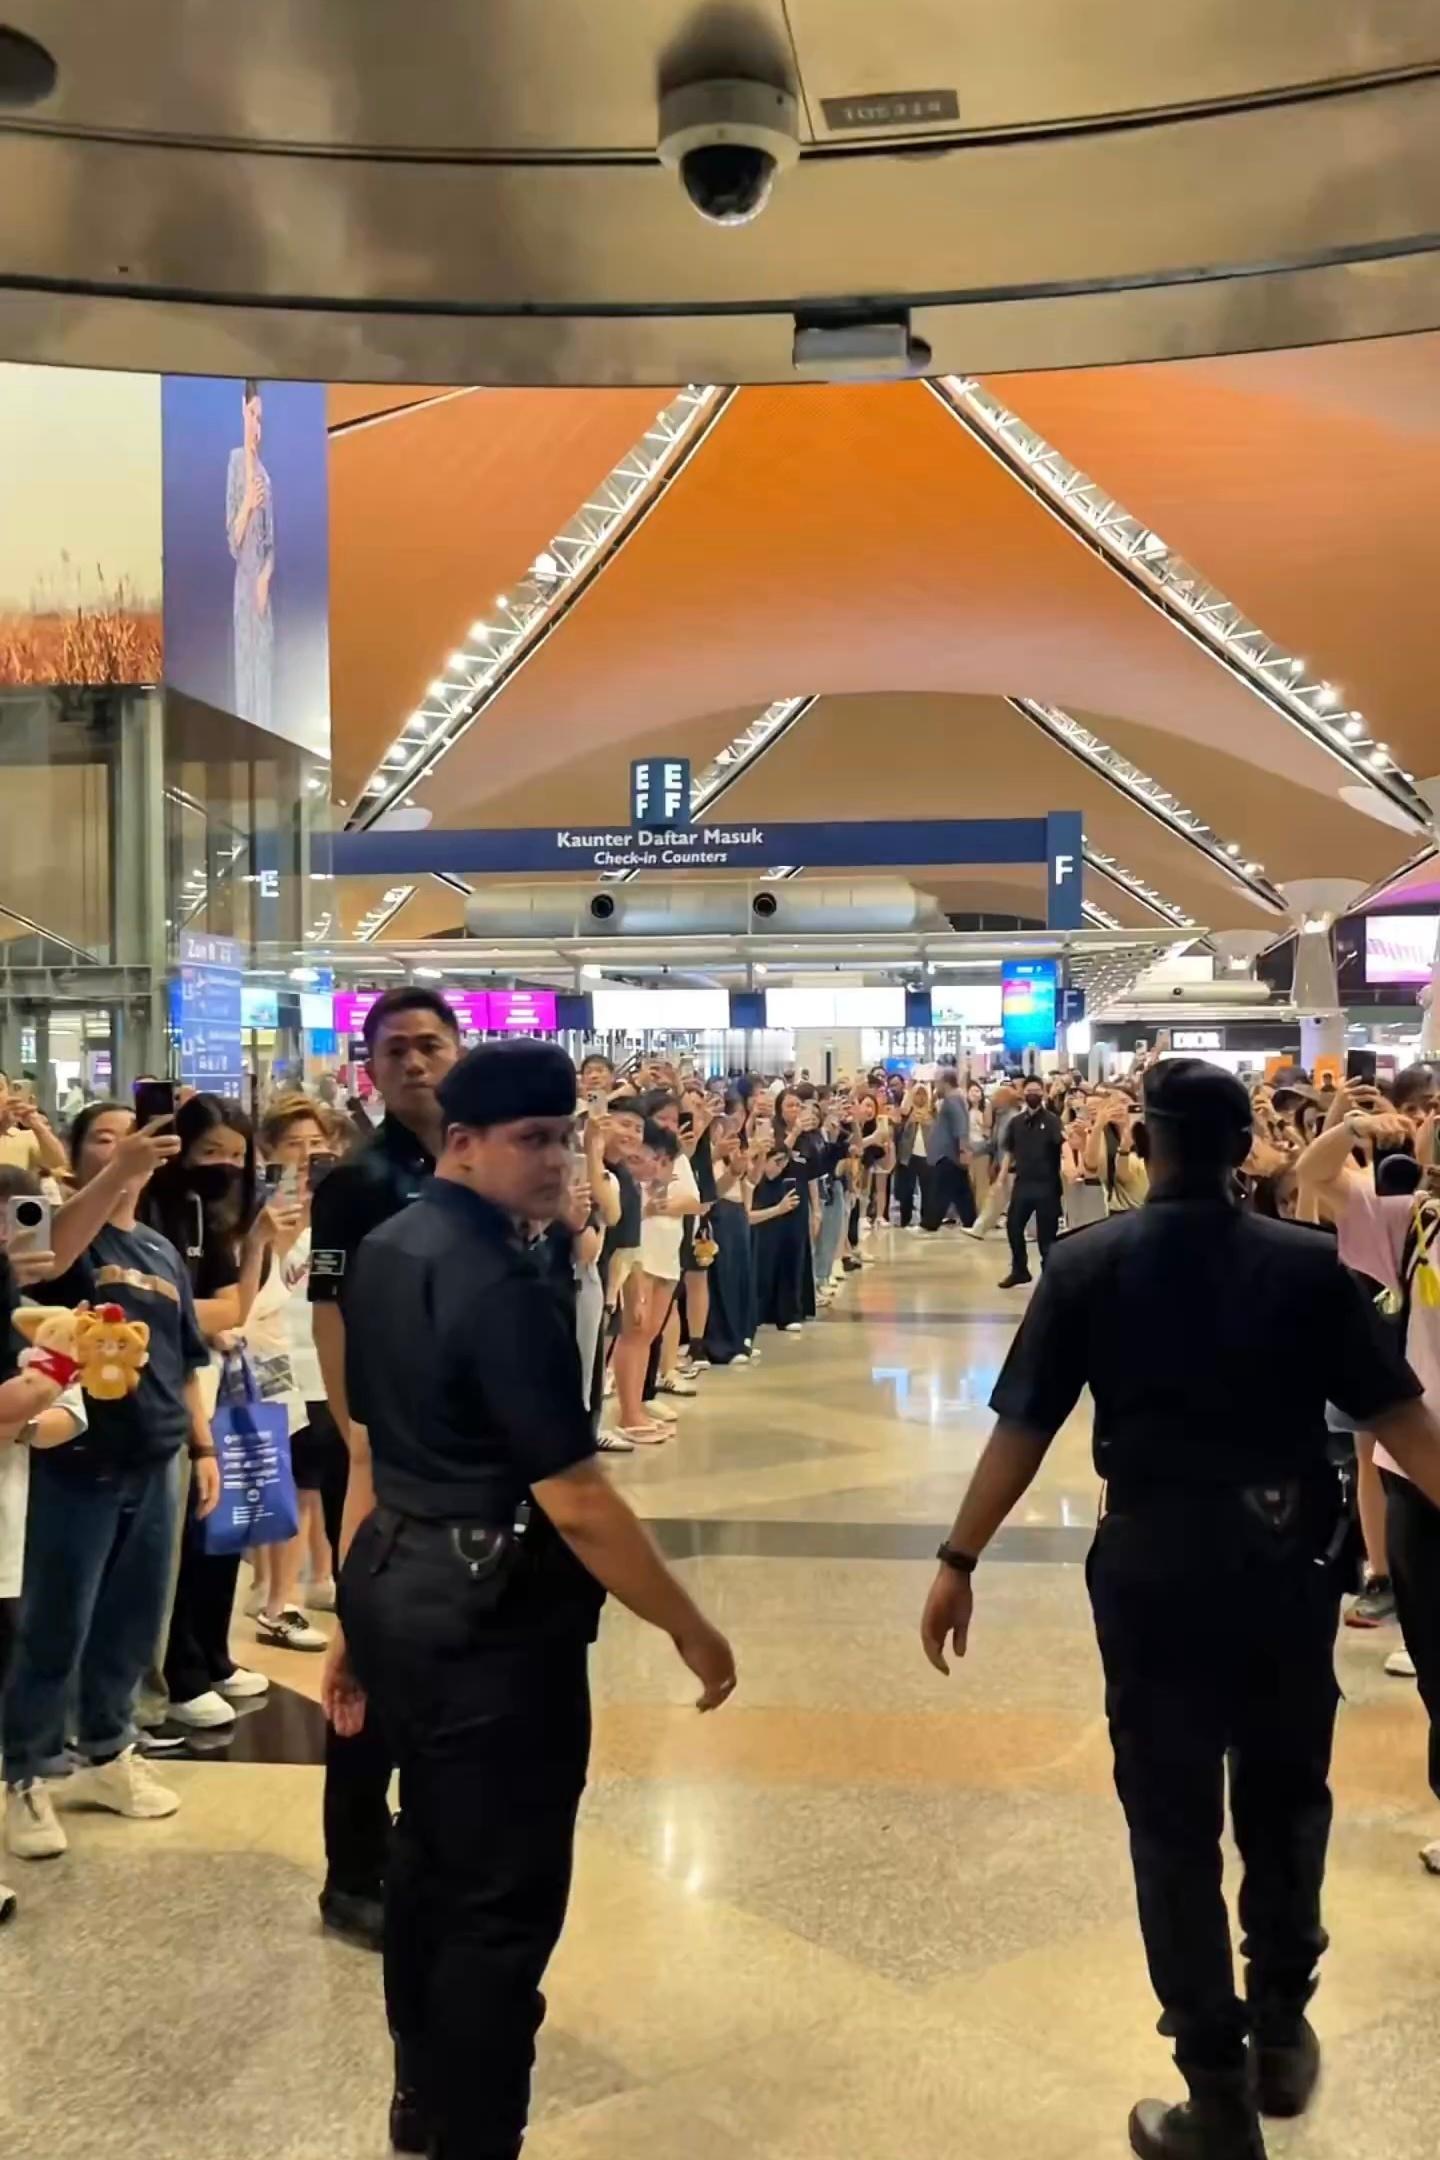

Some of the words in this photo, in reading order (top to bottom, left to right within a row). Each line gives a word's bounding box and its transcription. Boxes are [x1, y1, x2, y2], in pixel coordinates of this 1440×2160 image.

[635, 764, 649, 790] E
[664, 764, 683, 789] E
[635, 793, 648, 818] F
[664, 792, 681, 818] F
[556, 831, 632, 849] Kaunter
[638, 829, 698, 847] Daftar
[704, 828, 763, 845] Masuk
[593, 851, 657, 866] Check-in
[662, 849, 728, 865] Counters
[1055, 855, 1074, 885] F
[260, 870, 280, 898] E
[1063, 990, 1078, 1021] F
